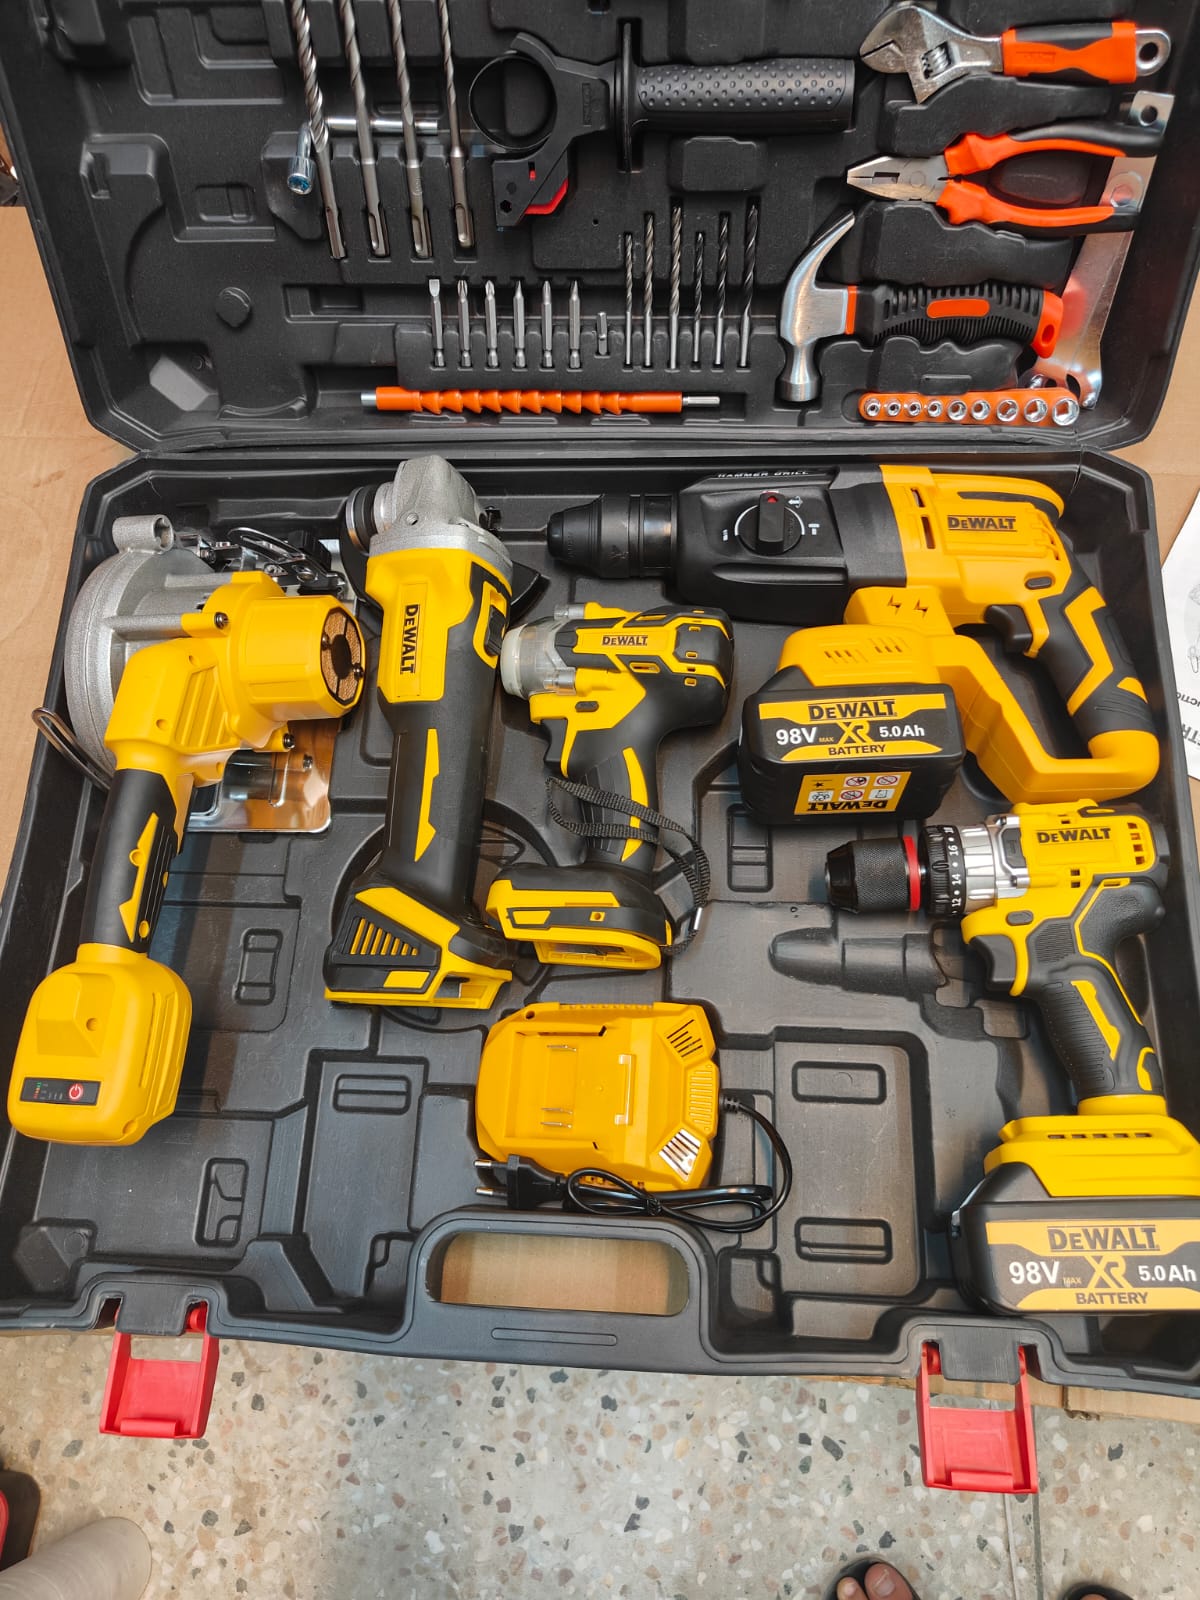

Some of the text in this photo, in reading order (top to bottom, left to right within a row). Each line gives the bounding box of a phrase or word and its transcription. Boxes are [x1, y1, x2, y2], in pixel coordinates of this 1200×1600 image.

[775, 727, 818, 746] 98V
[836, 720, 874, 744] XR
[879, 725, 925, 738] 5.0Ah
[828, 744, 886, 756] BATTERY
[807, 800, 888, 811] DEWALT
[948, 844, 959, 856] 16
[952, 873, 962, 886] 14
[951, 898, 961, 907] 12
[1009, 1260, 1060, 1285] 98V
[1084, 1254, 1133, 1289] XR
[1137, 1264, 1197, 1283] 5.0Ah
[1075, 1292, 1148, 1305] BATTERY
